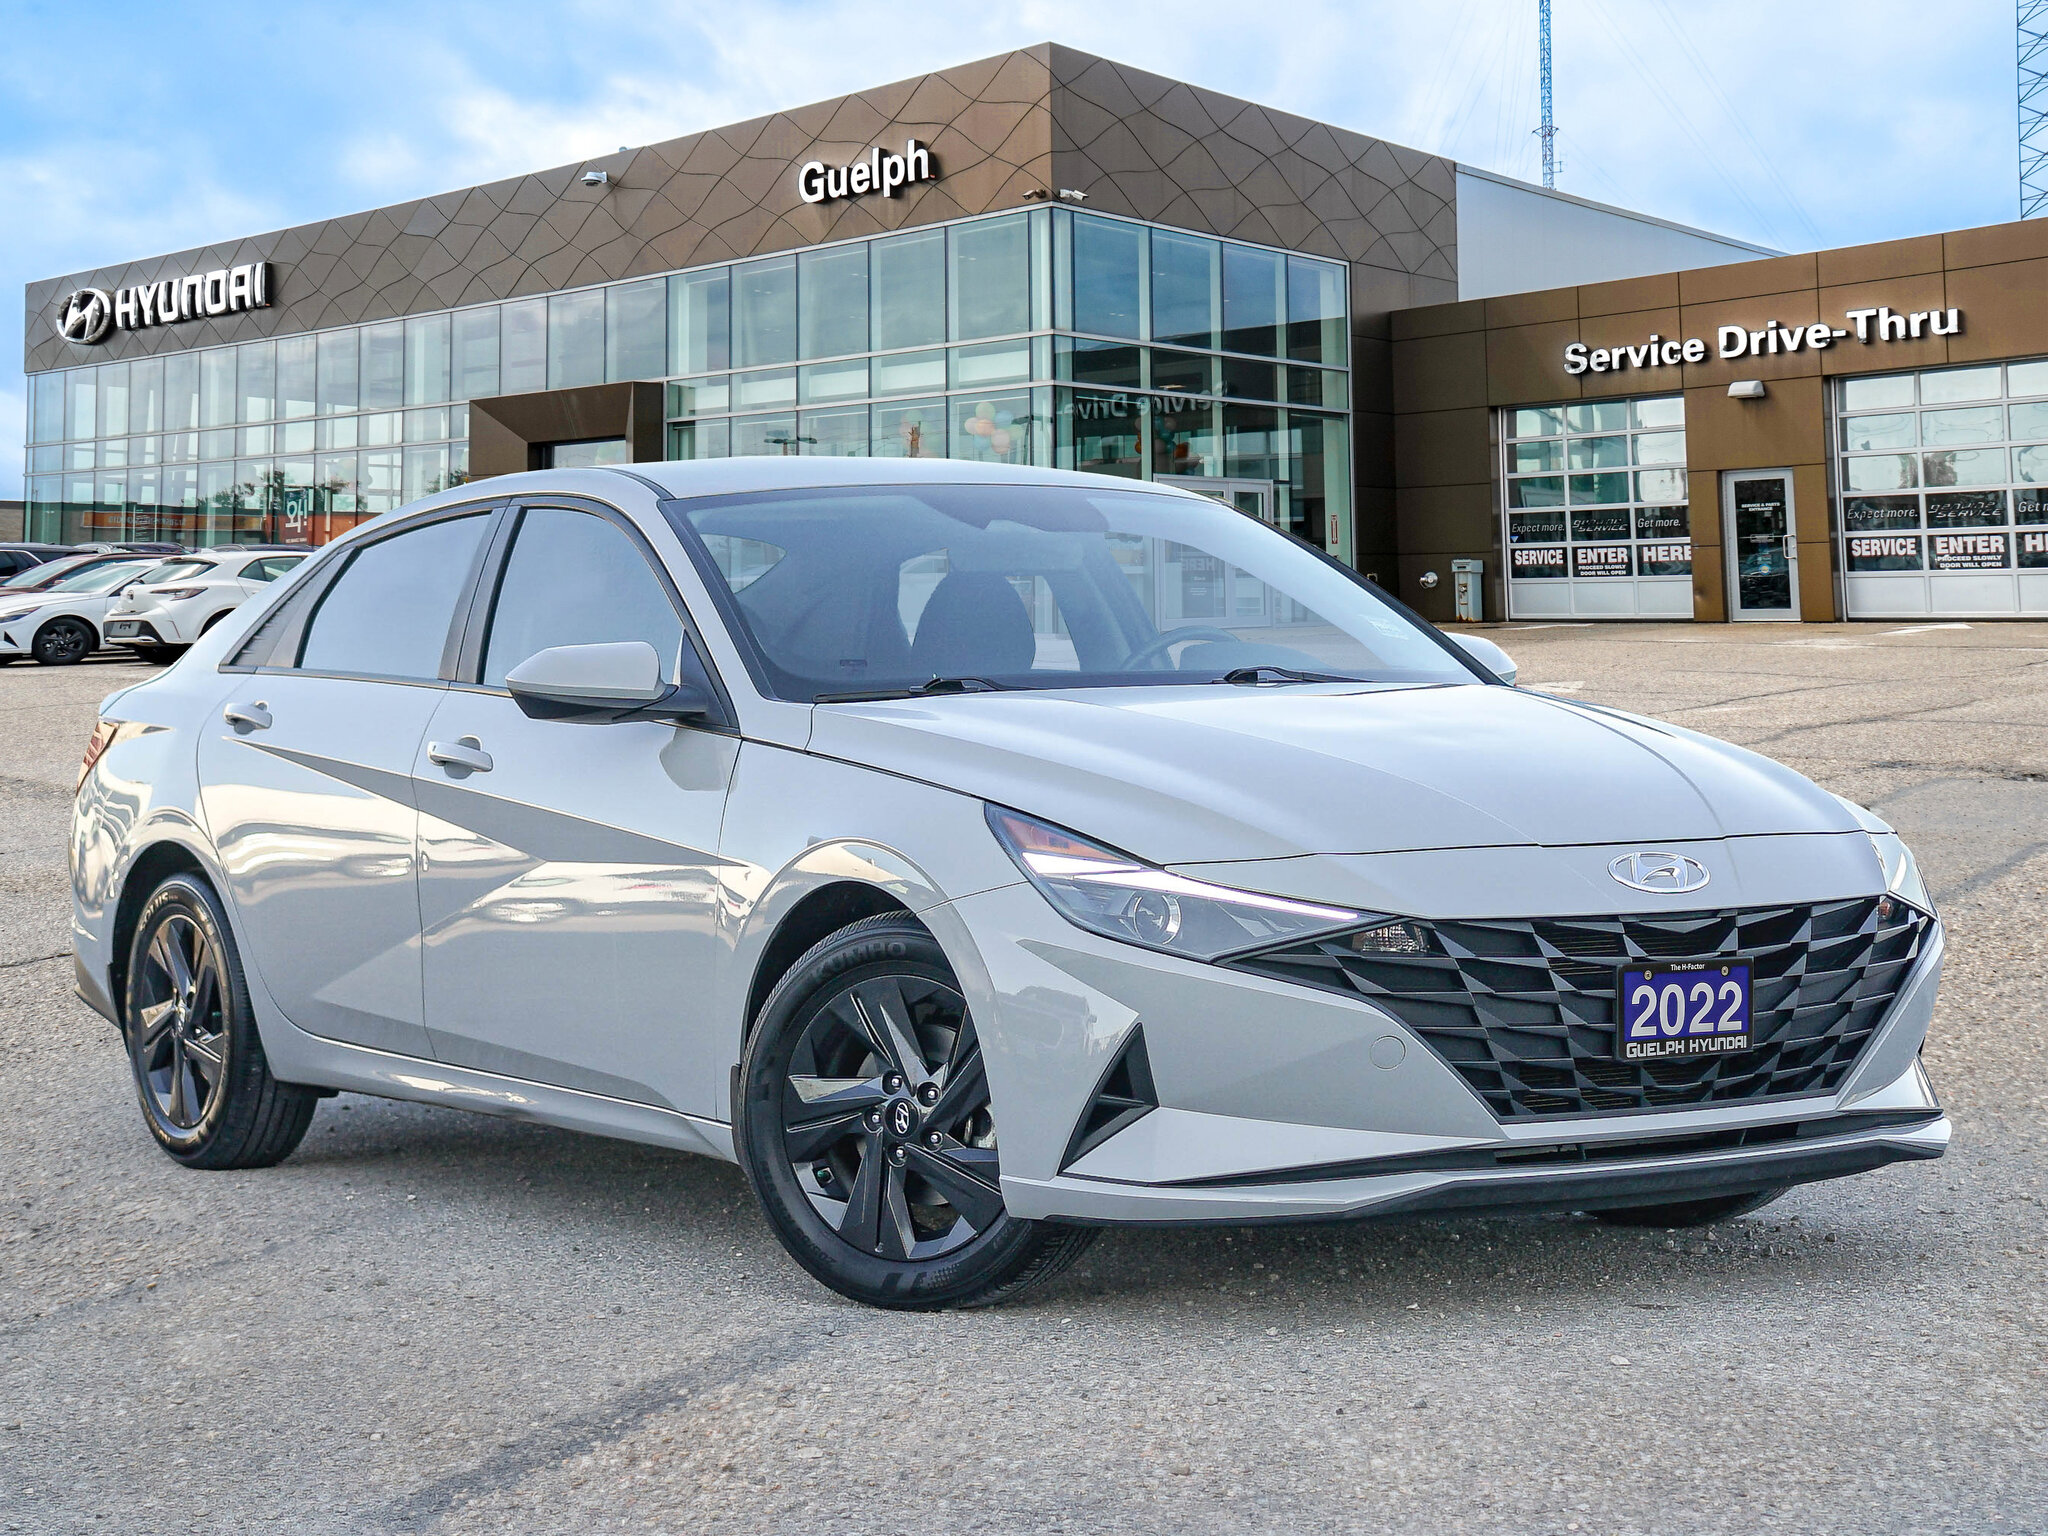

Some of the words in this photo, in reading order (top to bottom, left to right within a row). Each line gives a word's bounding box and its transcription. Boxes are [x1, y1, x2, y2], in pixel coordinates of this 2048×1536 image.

[798, 138, 930, 203] Guelph
[115, 262, 268, 329] HYUNDAI
[1563, 334, 1705, 375] Service
[1717, 306, 1961, 359] Drive-Thru
[1847, 508, 1884, 520] Expect
[1887, 508, 1918, 518] more.
[2018, 501, 2041, 513] Get
[1511, 523, 1540, 534] Expect
[1541, 523, 1565, 532] more.
[1637, 518, 1654, 528] Get
[1655, 518, 1681, 528] more.
[1851, 538, 1917, 557] SERVICE
[1936, 535, 2005, 554] ENTER
[1514, 549, 1563, 565] SERVICE
[1577, 547, 1629, 564] ENTER
[1681, 963, 1706, 971] H-Factor
[1630, 981, 1743, 1037] 2022
[1626, 1039, 1685, 1059] GUELPH
[1689, 1035, 1747, 1053] HYUNDAI
